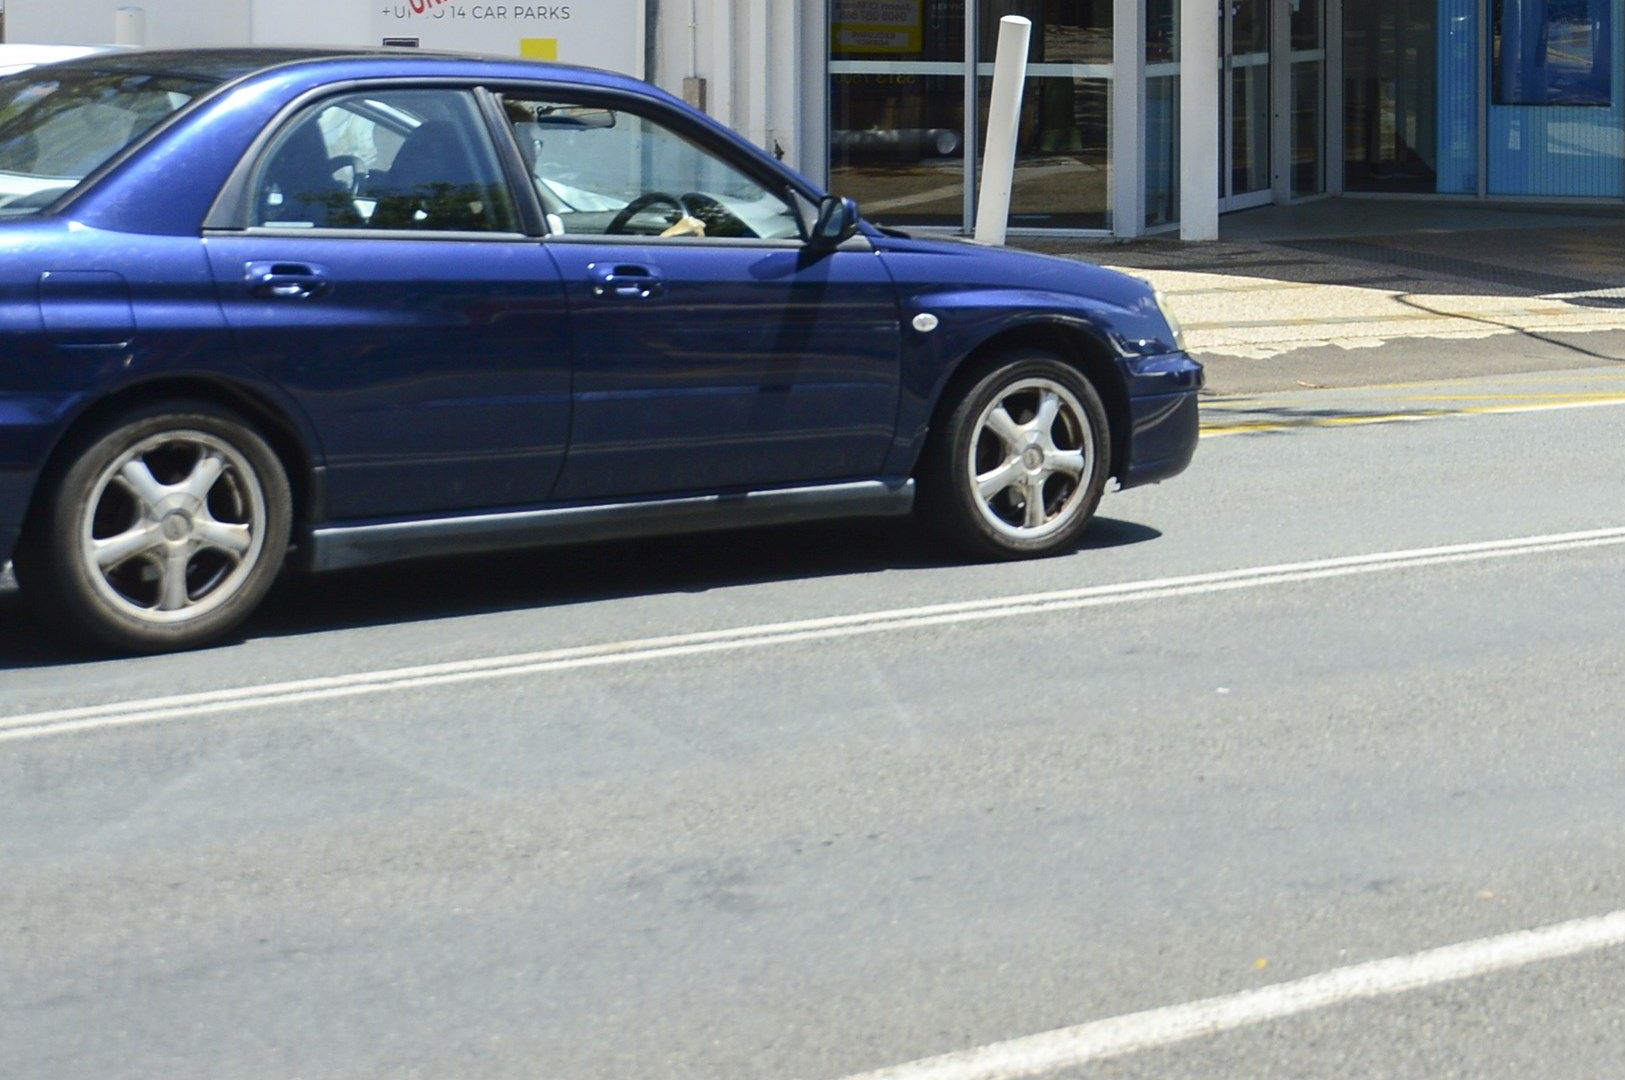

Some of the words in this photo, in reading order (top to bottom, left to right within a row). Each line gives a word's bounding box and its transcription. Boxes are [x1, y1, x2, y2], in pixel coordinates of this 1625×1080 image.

[451, 6, 465, 19] 14
[472, 6, 507, 19] CAR
[514, 6, 570, 20] PARKS
